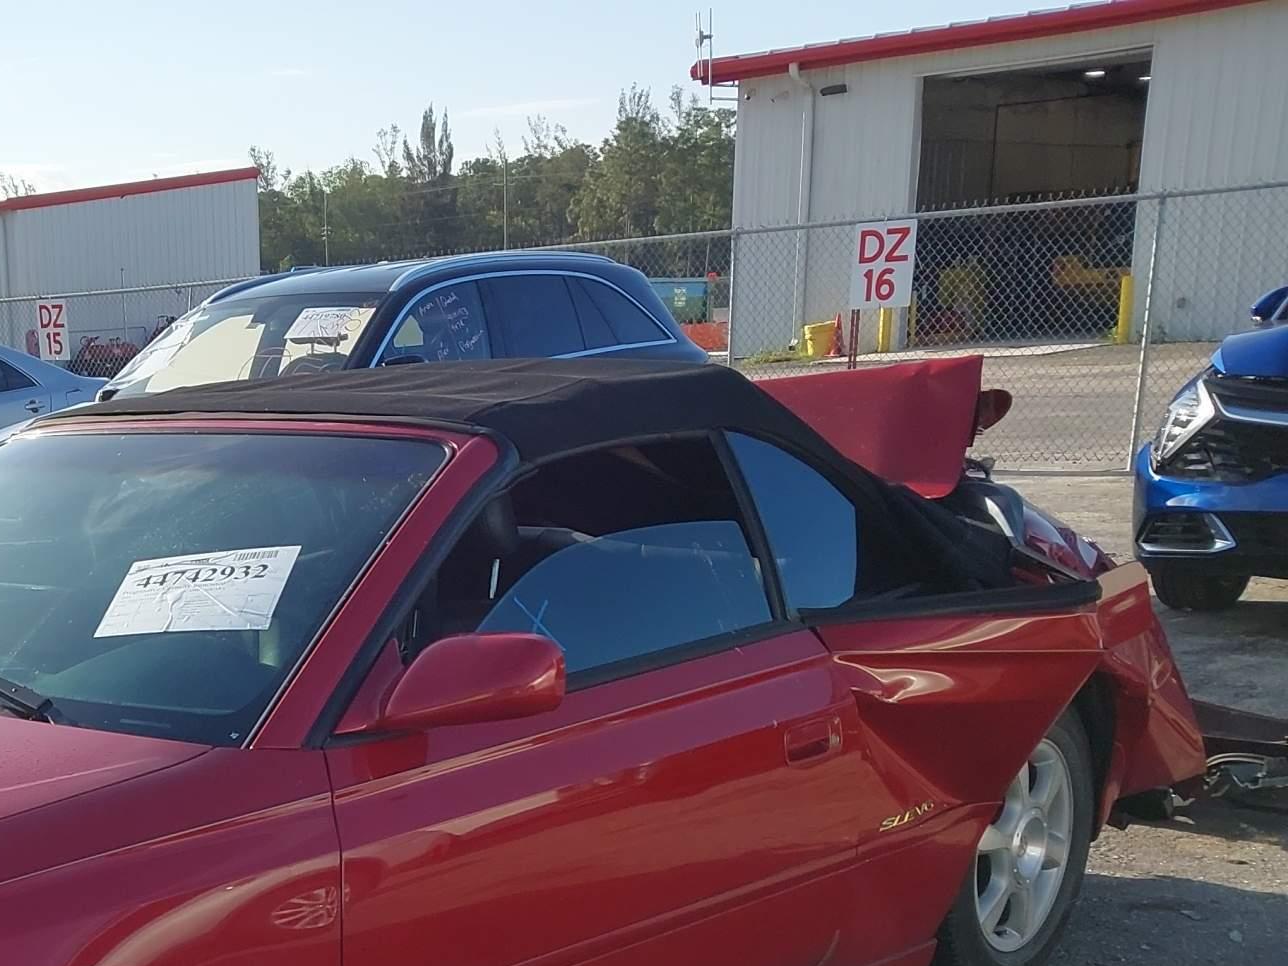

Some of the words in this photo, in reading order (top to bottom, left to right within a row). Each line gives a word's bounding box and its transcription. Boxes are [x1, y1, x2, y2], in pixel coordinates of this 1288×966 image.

[859, 227, 911, 264] DZ
[863, 268, 895, 302] 16
[39, 304, 65, 328] DZ
[46, 332, 63, 355] 15
[136, 564, 269, 588] 44742932
